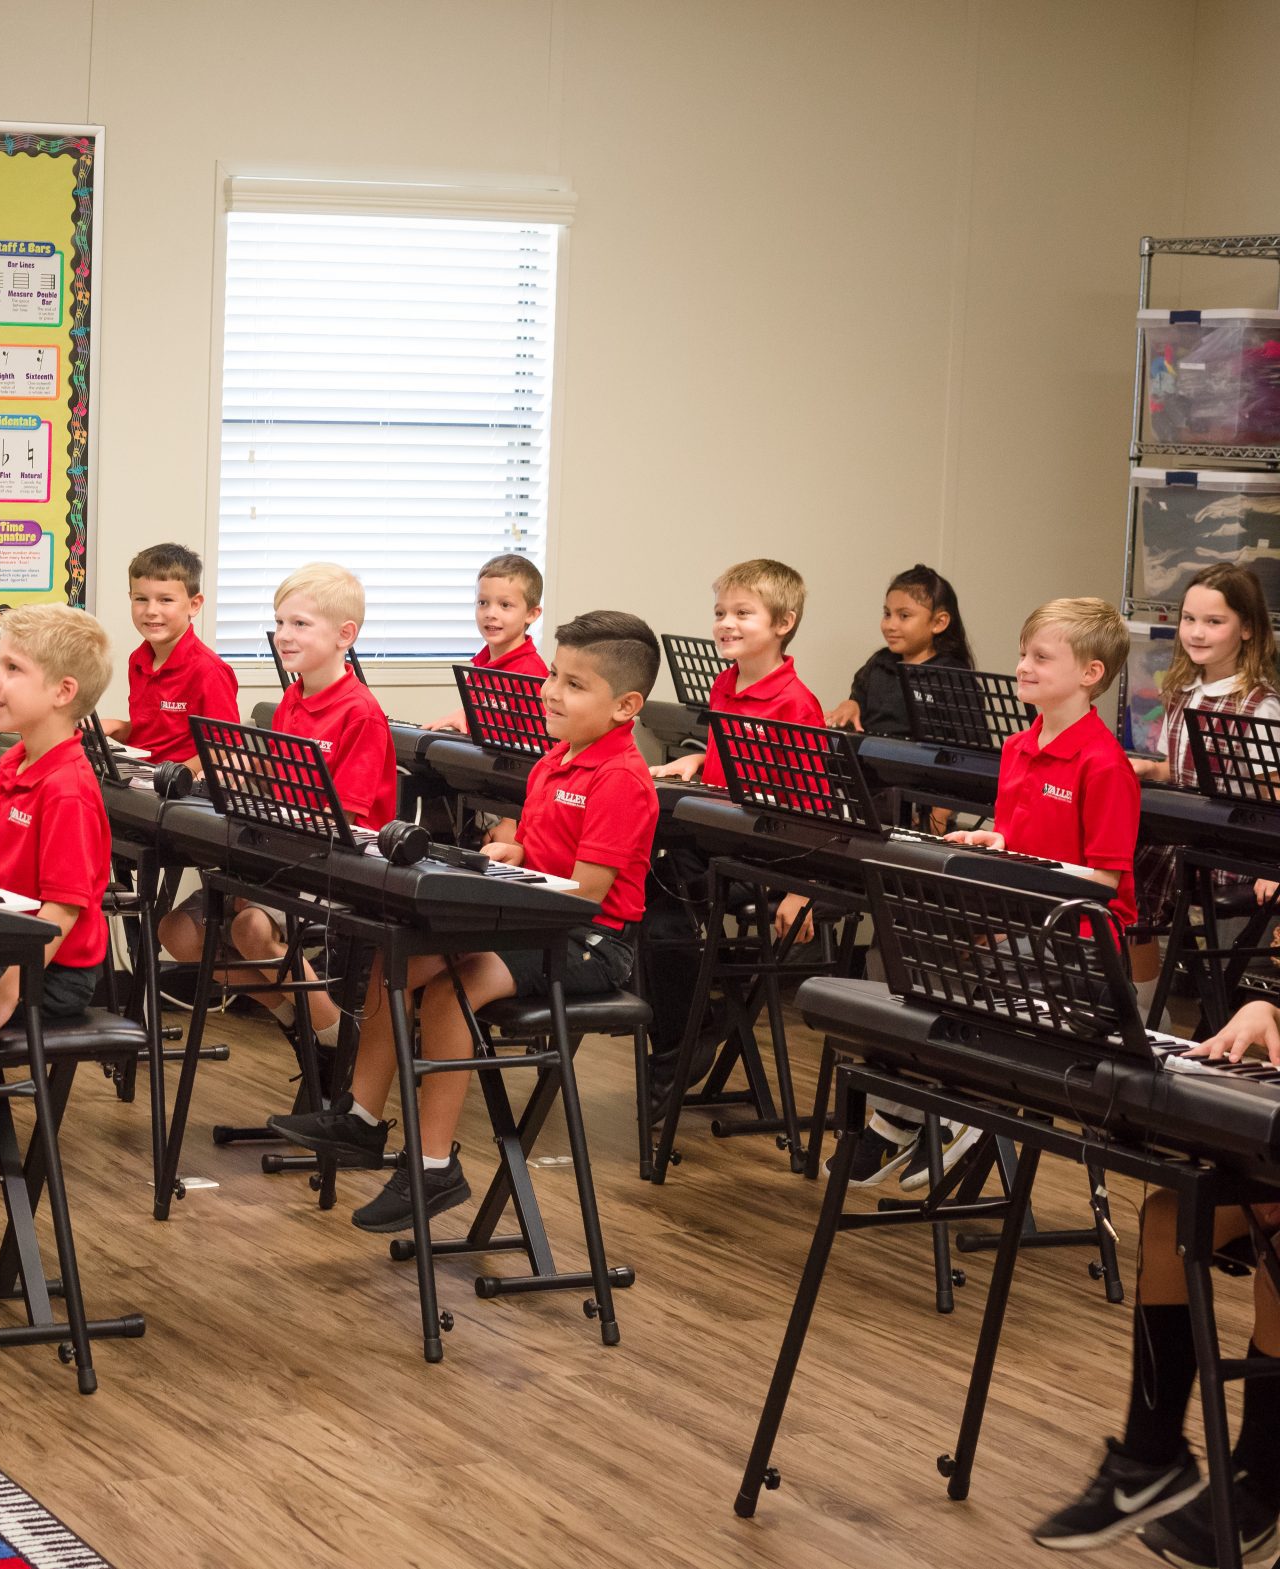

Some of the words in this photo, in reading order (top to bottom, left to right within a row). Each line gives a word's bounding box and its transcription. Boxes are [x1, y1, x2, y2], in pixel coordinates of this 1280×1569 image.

[19, 242, 26, 253] &
[28, 243, 51, 254] Bars
[7, 290, 33, 298] Measure
[25, 373, 54, 381] Sixteenth
[0, 521, 25, 532] Time
